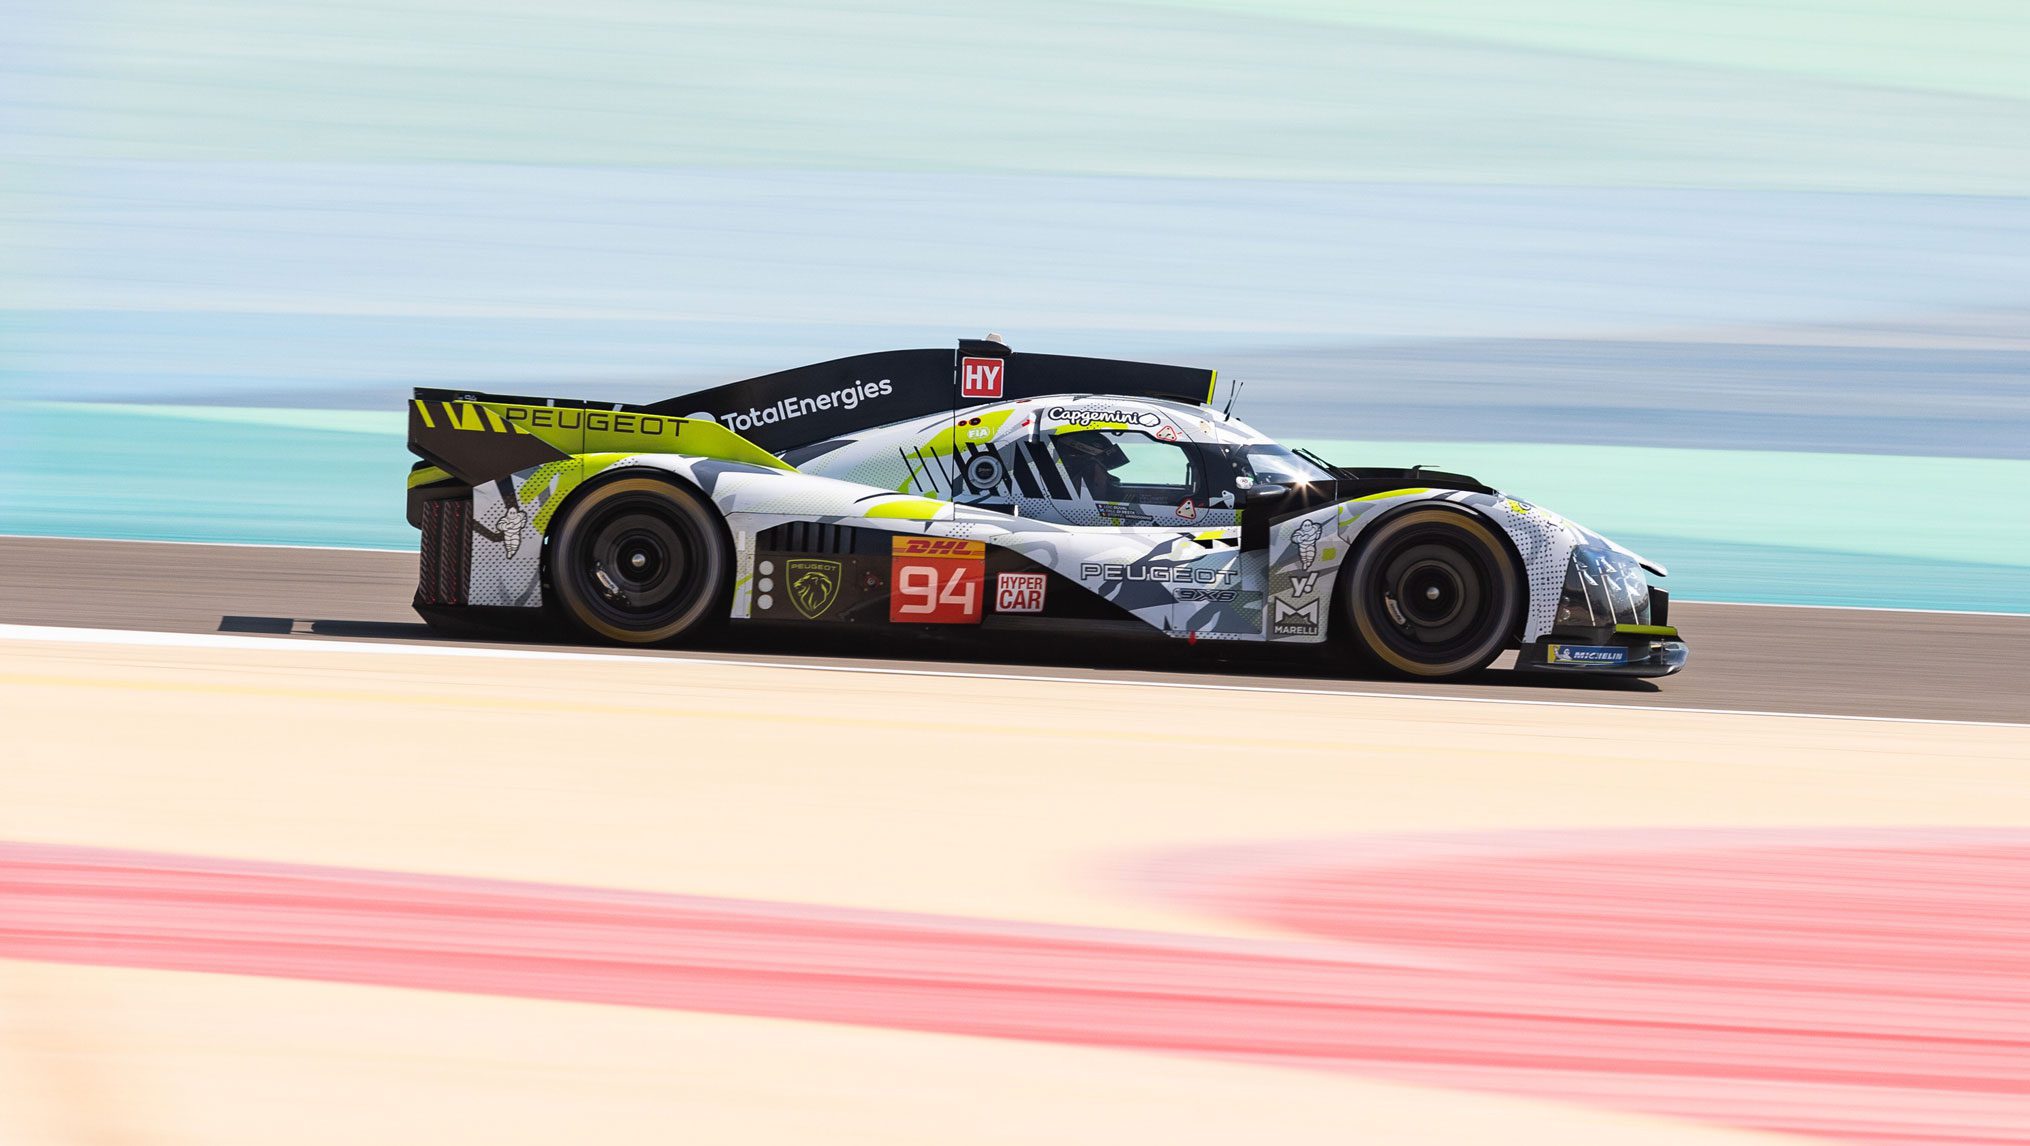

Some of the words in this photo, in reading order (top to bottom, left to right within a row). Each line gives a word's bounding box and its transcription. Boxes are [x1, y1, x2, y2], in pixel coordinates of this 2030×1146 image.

[965, 365, 1000, 390] HY
[721, 378, 893, 433] TotalEnergies
[506, 408, 689, 437] PEUGEOT
[1048, 407, 1140, 426] Capgemini
[968, 429, 988, 438] FIA
[906, 539, 972, 556] DHL
[791, 563, 836, 571] PEUGEOT
[1080, 563, 1237, 584] PEUGEOT
[899, 565, 975, 615] 94
[1001, 575, 1043, 590] HYPER
[999, 589, 1042, 610] CAR
[1179, 588, 1239, 602] 9X8
[1274, 625, 1318, 635] MARELLI
[1573, 651, 1624, 660] MICHELIN
